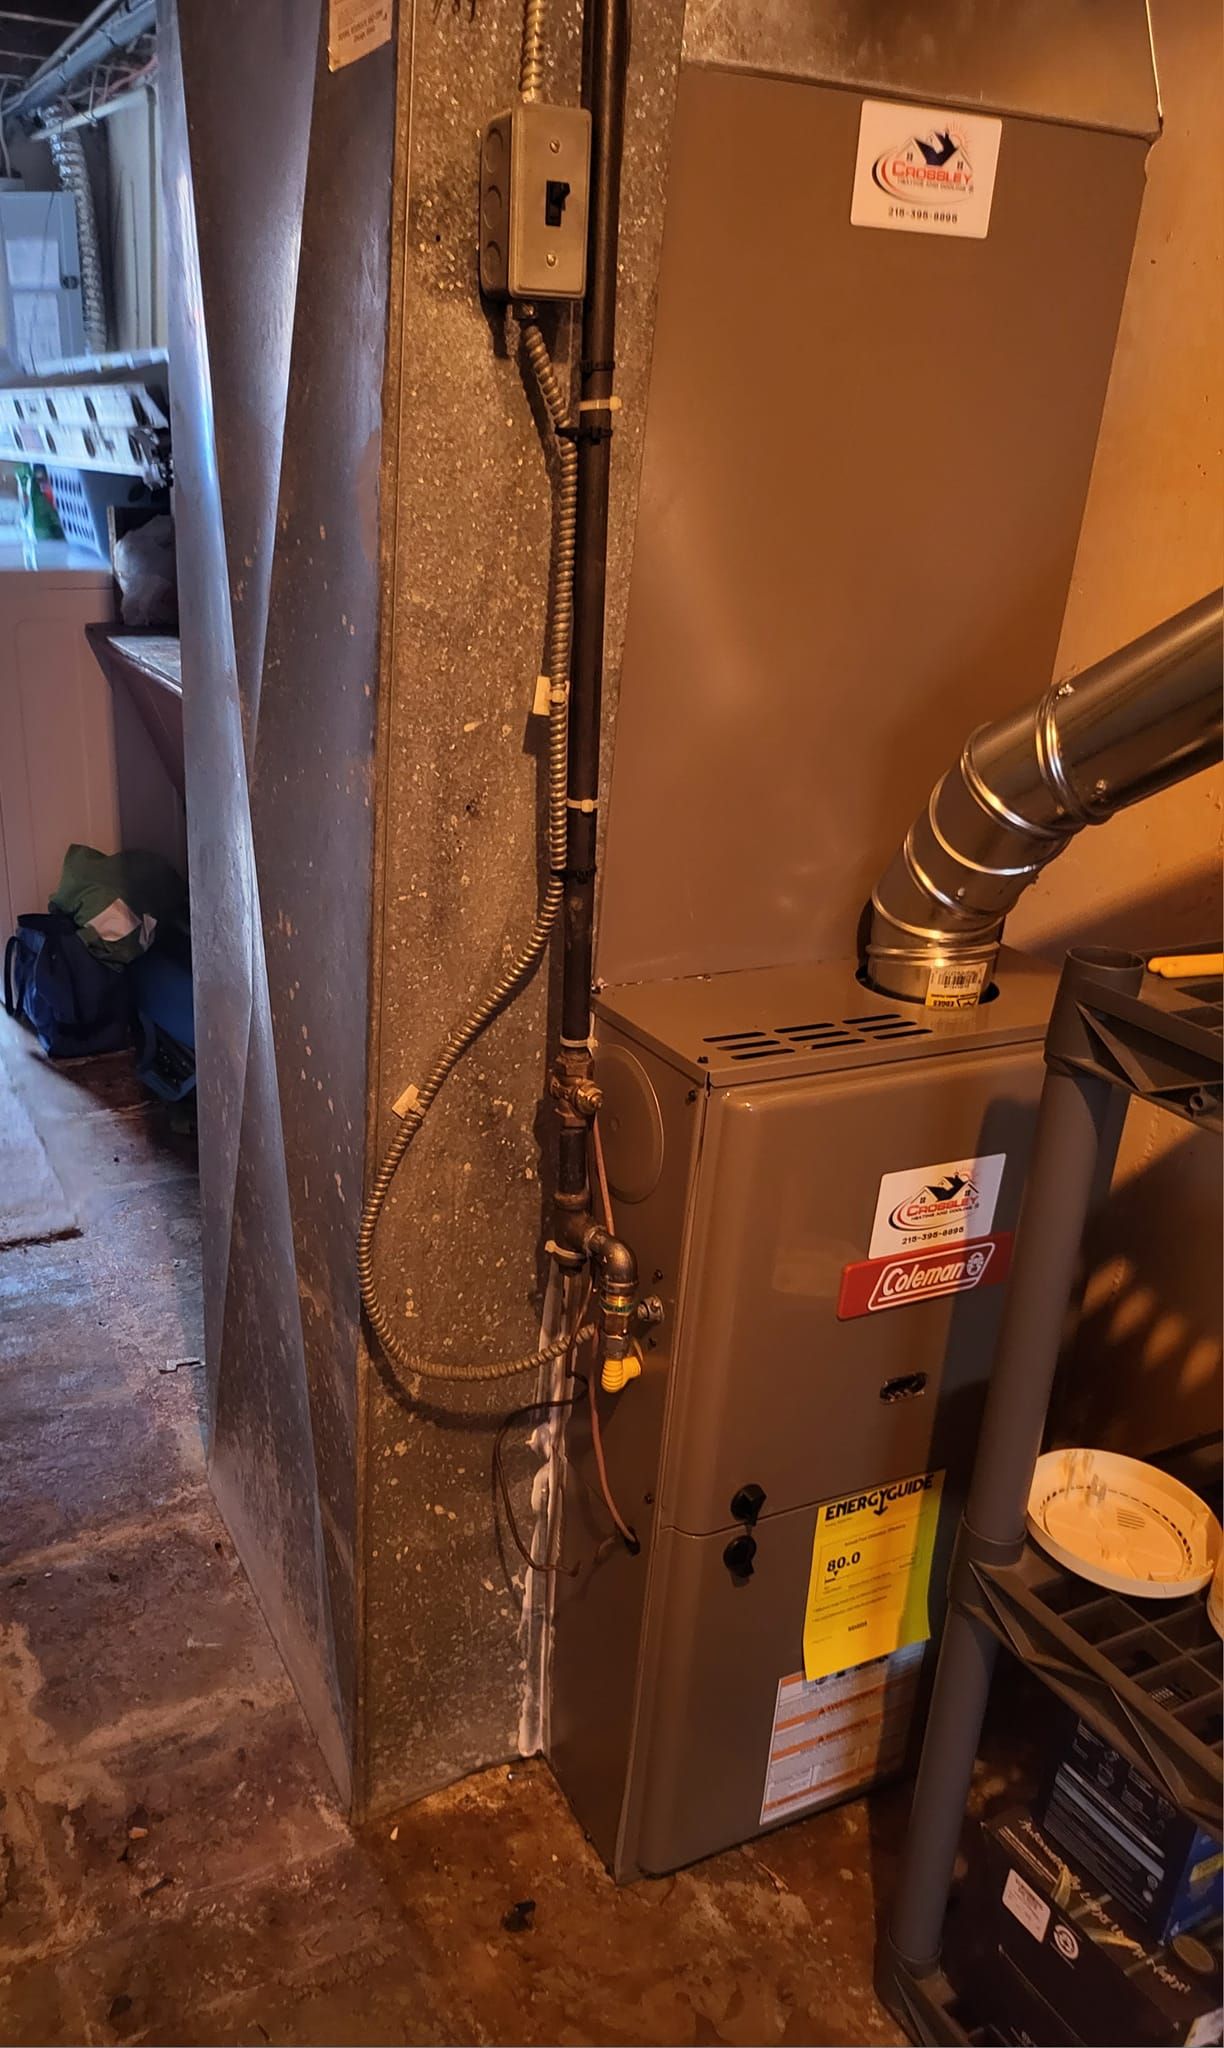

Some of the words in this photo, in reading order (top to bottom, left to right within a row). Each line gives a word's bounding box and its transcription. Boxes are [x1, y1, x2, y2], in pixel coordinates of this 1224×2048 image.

[892, 160, 974, 185] CROSSLEY
[906, 1196, 978, 1217] CROSSLEY
[882, 1261, 966, 1296] Coleman
[824, 1473, 936, 1521] ENERGYGUIDE
[826, 1551, 861, 1573] 80.0
